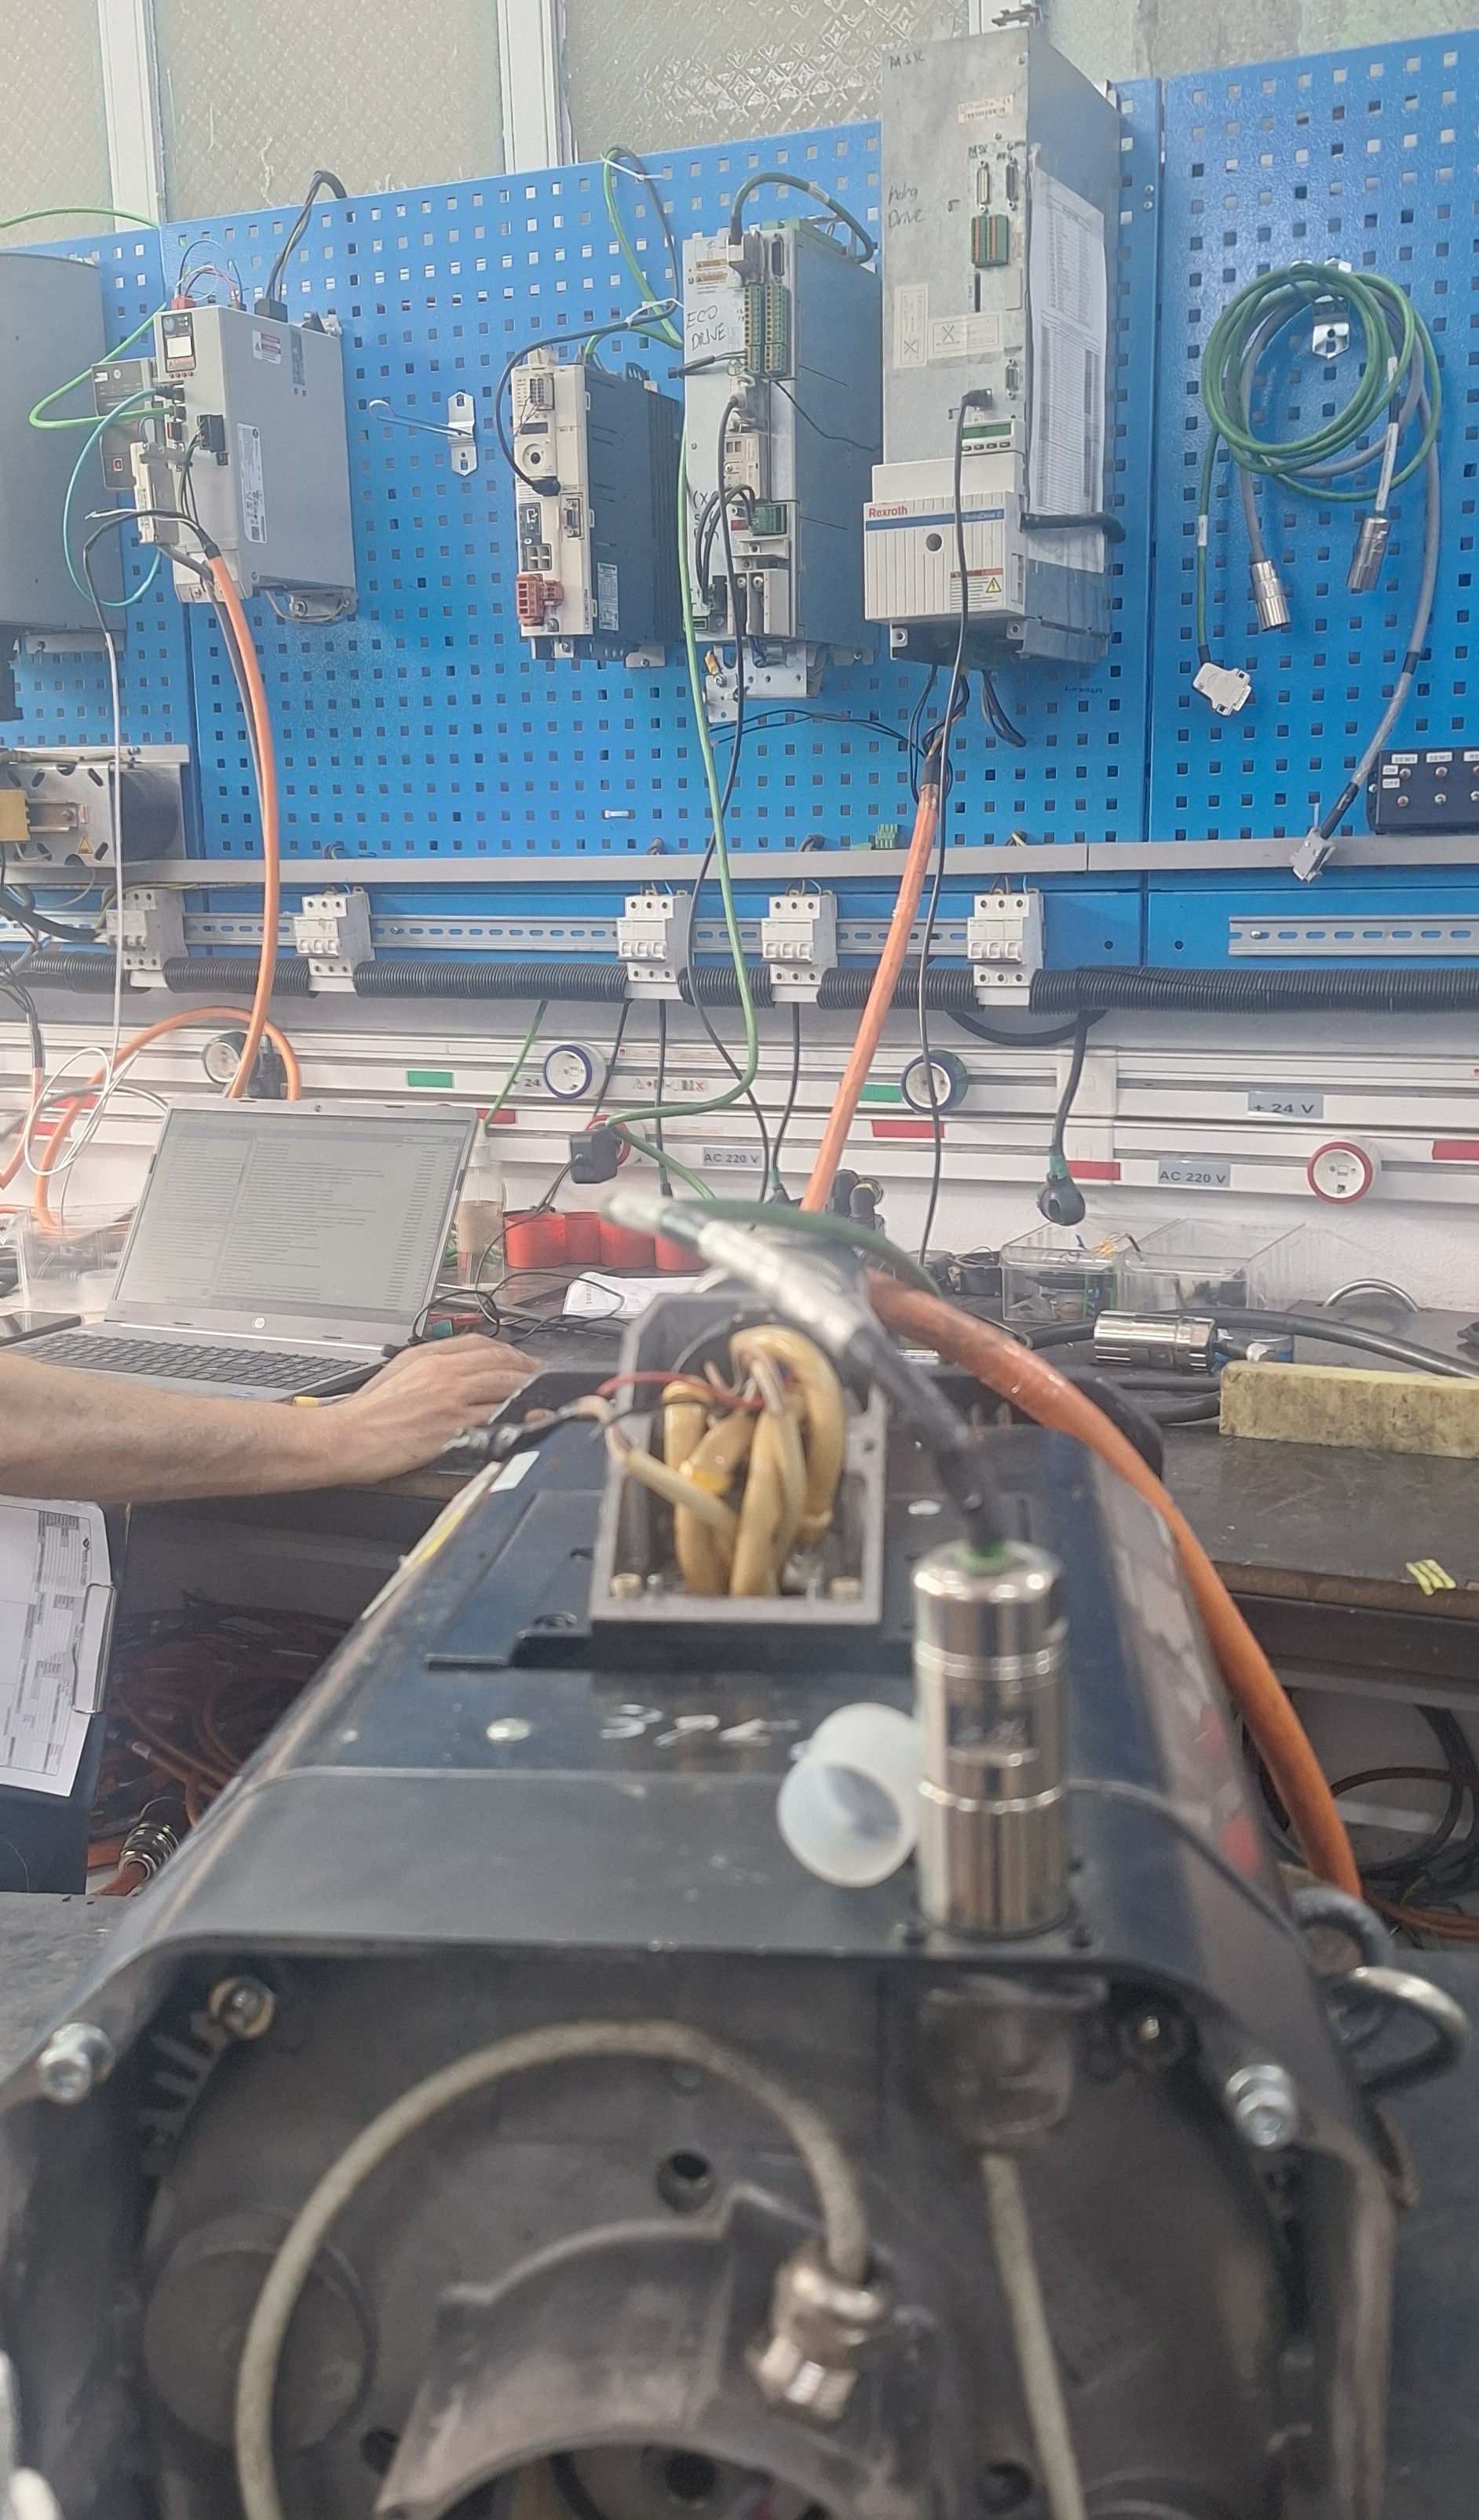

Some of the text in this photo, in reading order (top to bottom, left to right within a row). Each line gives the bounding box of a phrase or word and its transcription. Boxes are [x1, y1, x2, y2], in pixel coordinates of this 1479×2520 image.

[686, 305, 718, 330] ECO
[692, 323, 727, 351] DRIVE
[868, 505, 907, 518] Rexroth
[523, 1078, 542, 1088] 24
[1272, 1103, 1294, 1114] 24
[1301, 1103, 1315, 1114] V
[703, 1153, 760, 1164] AC 220 V
[1159, 1171, 1226, 1183] AC 220 V
